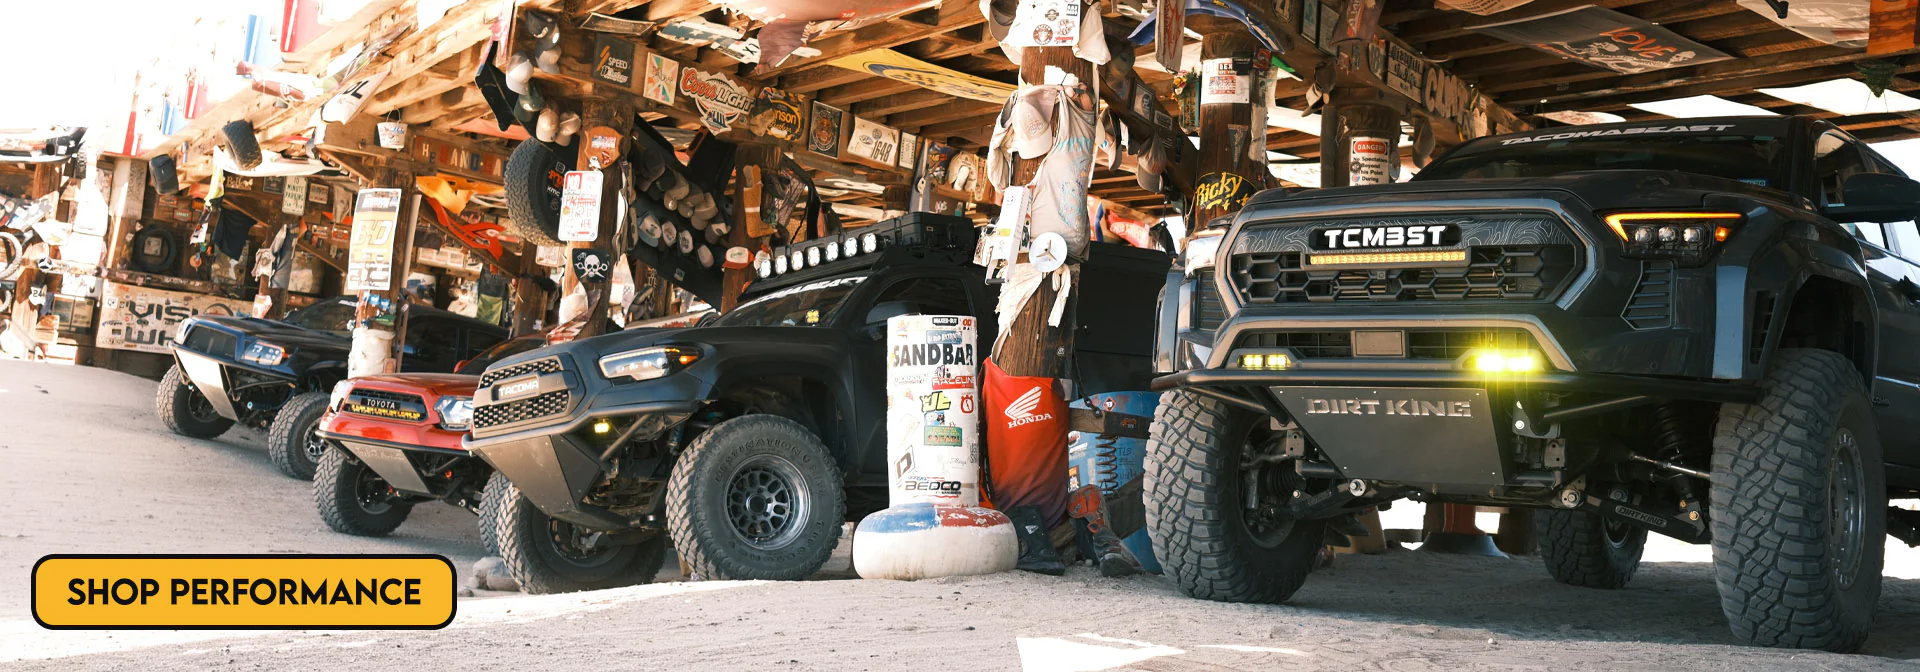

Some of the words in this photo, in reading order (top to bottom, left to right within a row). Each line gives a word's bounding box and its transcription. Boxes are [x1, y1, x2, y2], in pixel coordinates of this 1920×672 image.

[1598, 26, 1677, 59] LOVE
[608, 56, 628, 70] SPEED
[682, 67, 717, 100] Coors
[715, 87, 755, 113] LIGHT
[1501, 124, 1736, 146] TACOMABEAST
[870, 139, 893, 162] 1648
[1357, 143, 1385, 151] DANGER
[1195, 171, 1243, 206] Ricky
[893, 343, 974, 367] SANDBAR
[498, 379, 540, 397] TACOMA
[366, 398, 396, 409] TOYOTA
[1307, 399, 1380, 415] DIRT
[1386, 399, 1471, 417] KING
[1007, 413, 1053, 429] HONDA
[905, 480, 962, 491] BEDCO
